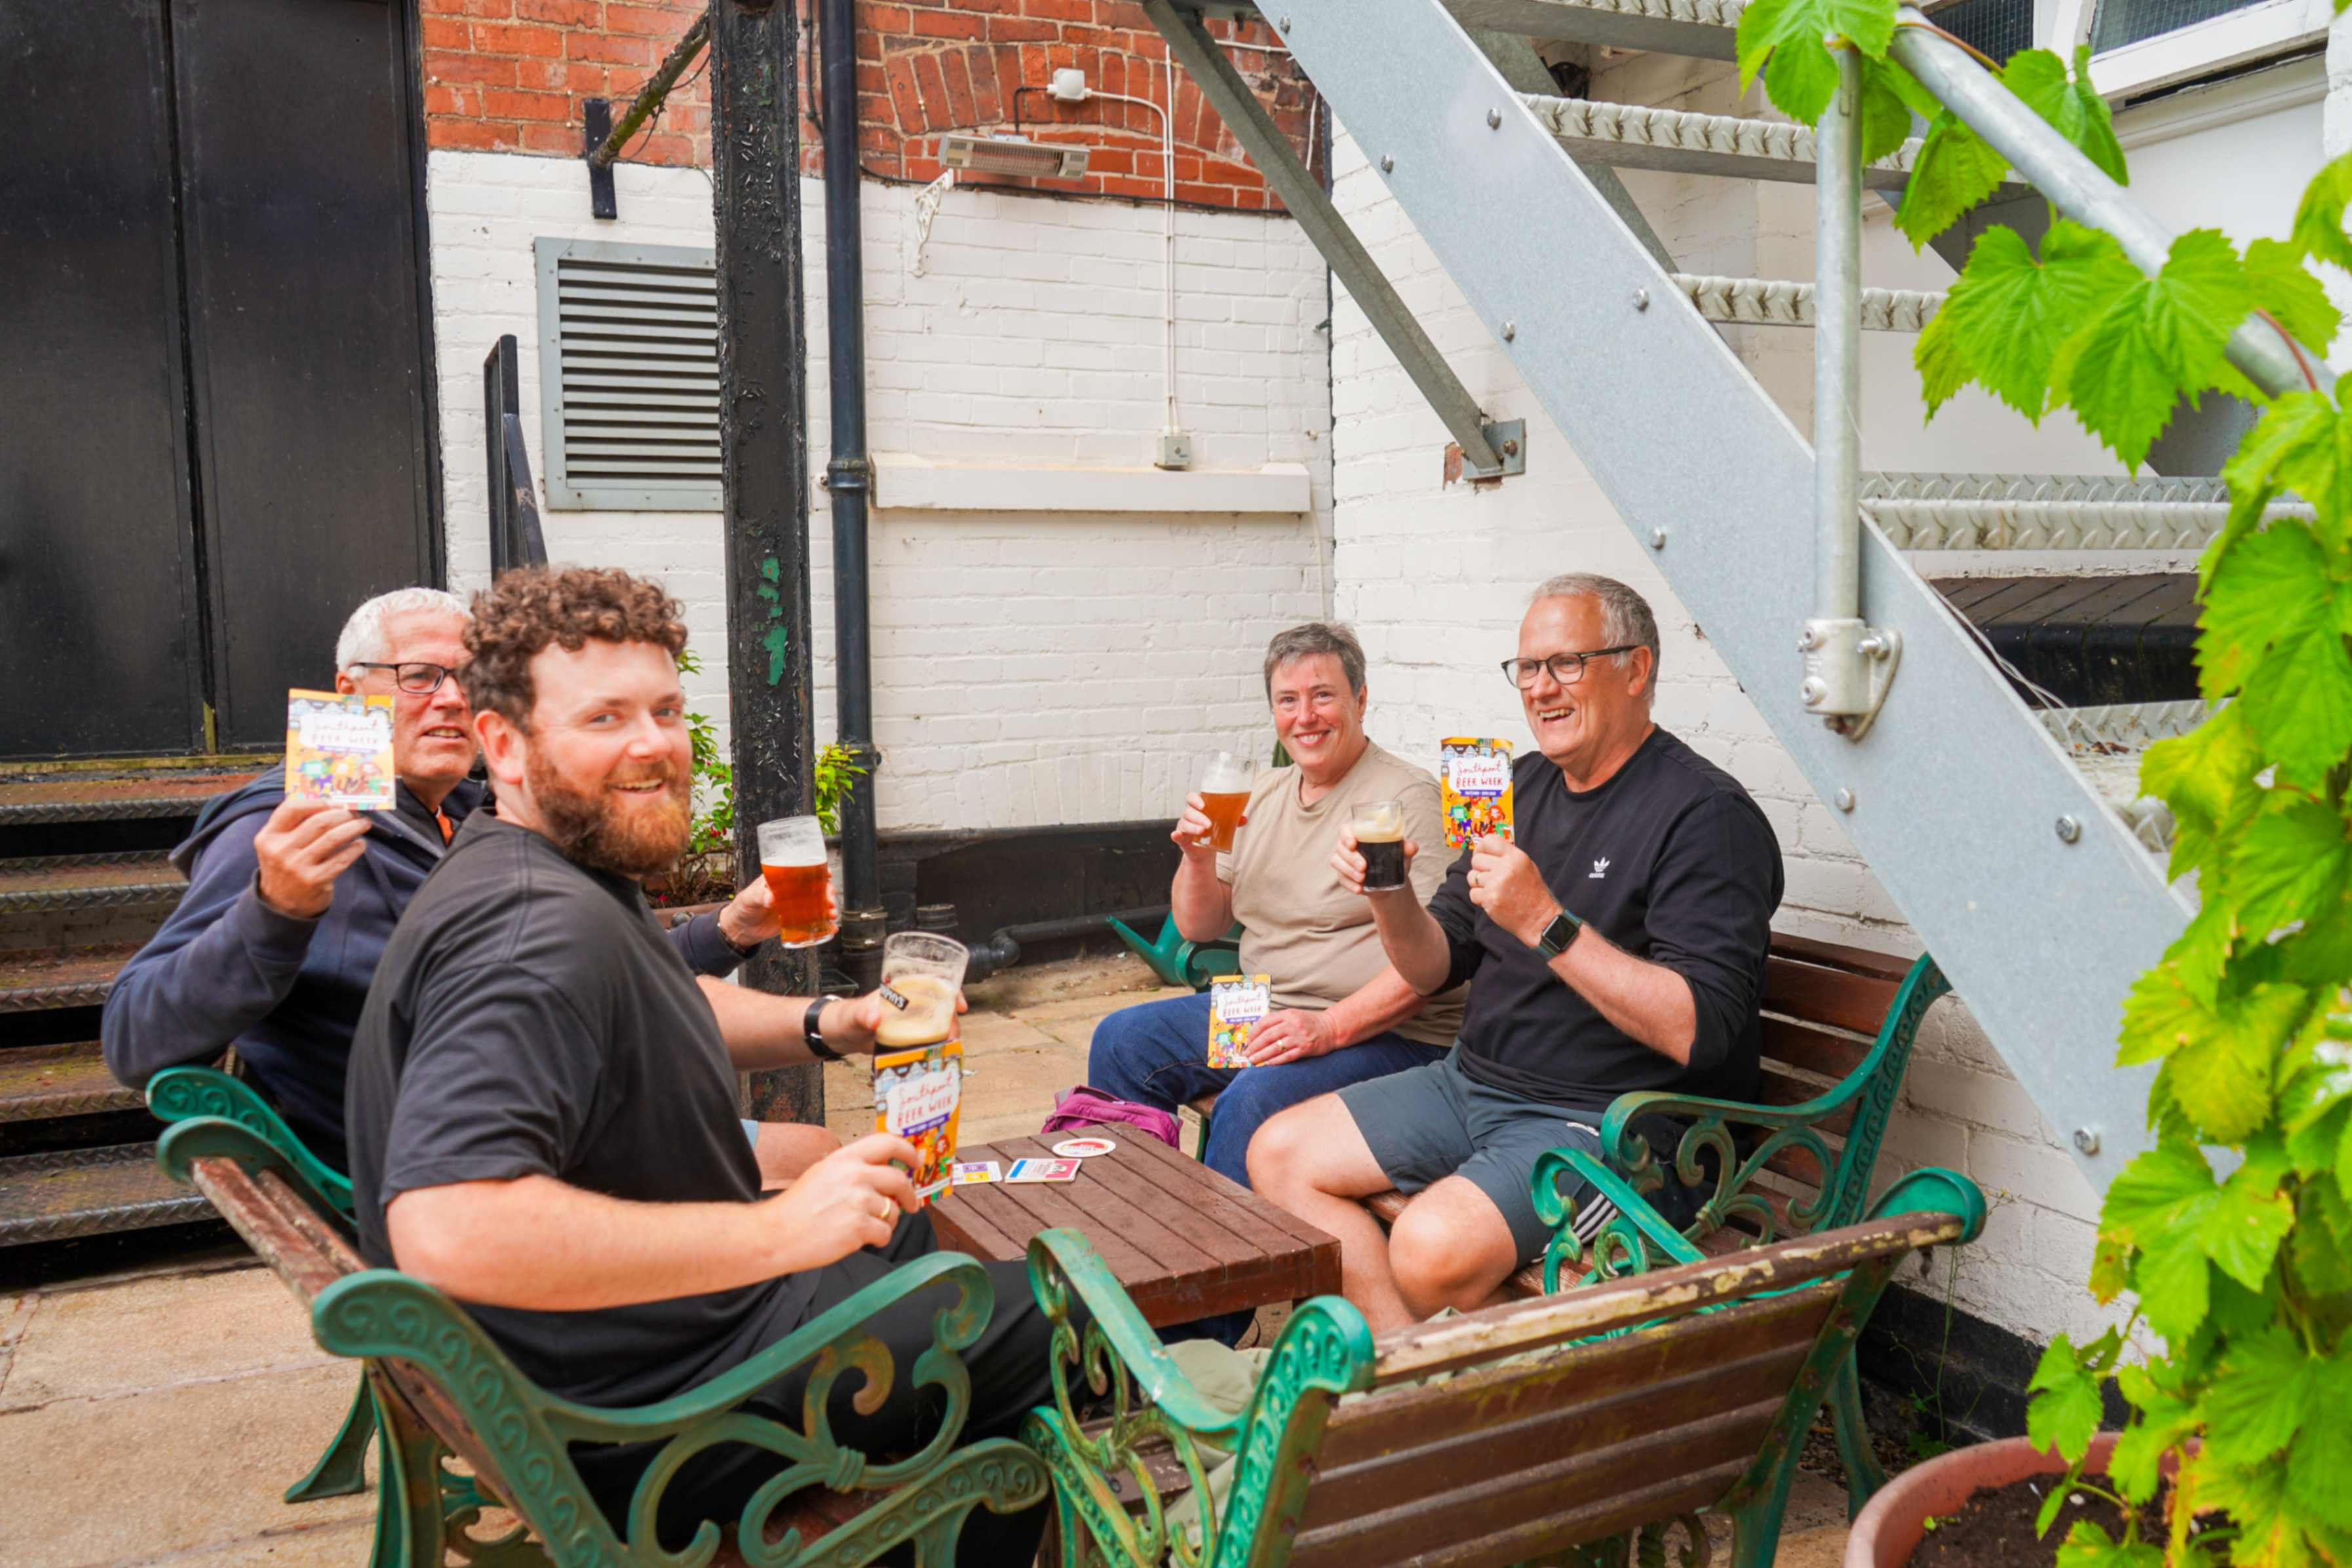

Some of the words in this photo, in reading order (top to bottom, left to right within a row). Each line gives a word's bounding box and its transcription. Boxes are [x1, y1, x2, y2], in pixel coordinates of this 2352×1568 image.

[1457, 760, 1501, 776] Southport
[1456, 777, 1477, 788] BEER
[1481, 777, 1503, 786] WEEK
[897, 1105, 923, 1128] BEER
[928, 1095, 953, 1113] WEEK
